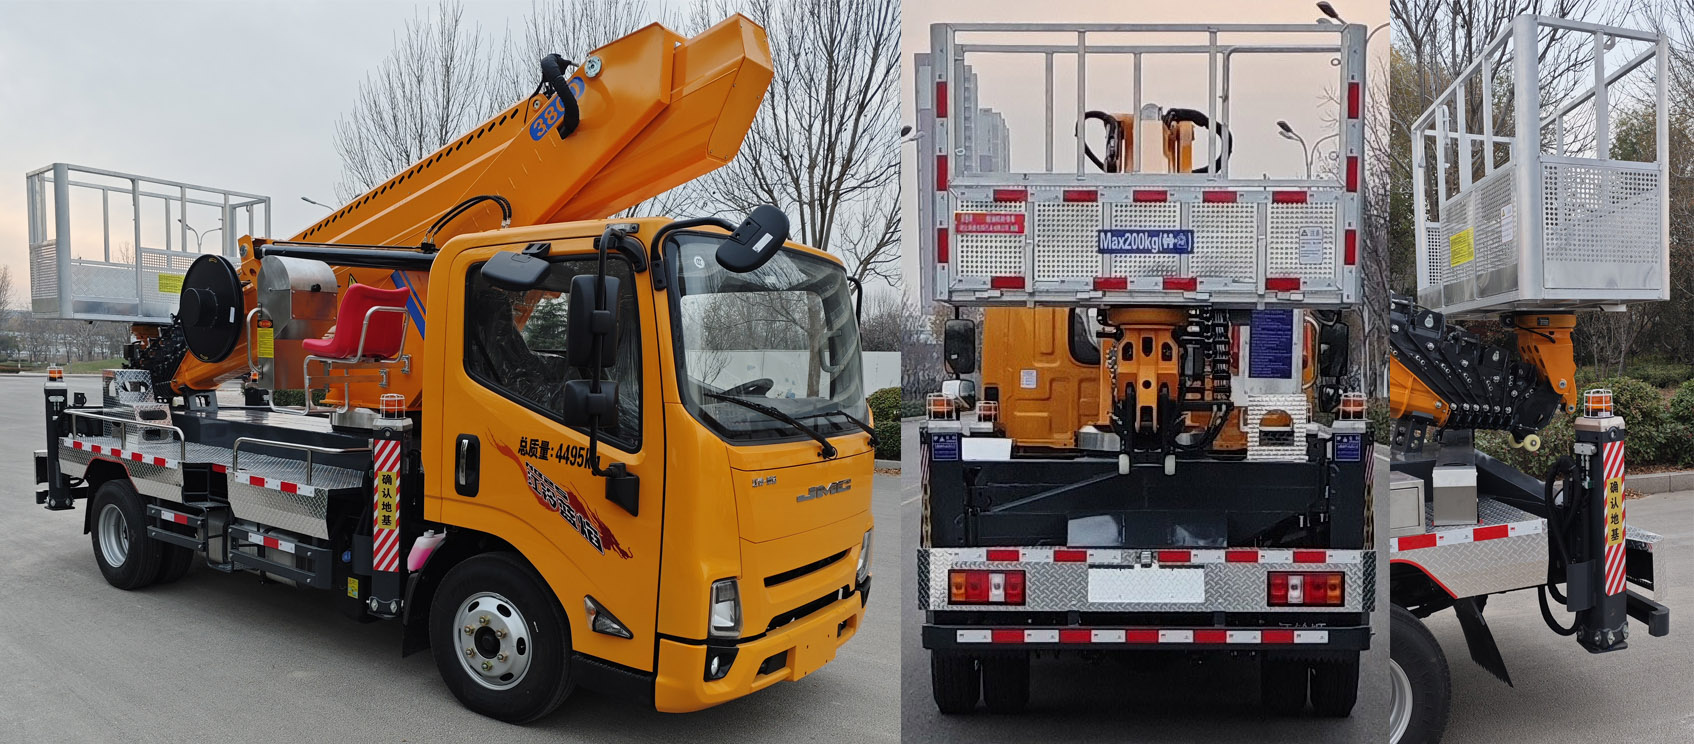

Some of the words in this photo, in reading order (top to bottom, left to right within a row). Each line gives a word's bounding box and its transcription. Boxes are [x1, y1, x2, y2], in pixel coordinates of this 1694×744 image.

[381, 474, 393, 527] 确认地基
[796, 478, 852, 503] JMC
[1609, 480, 1620, 542] 确认地基
